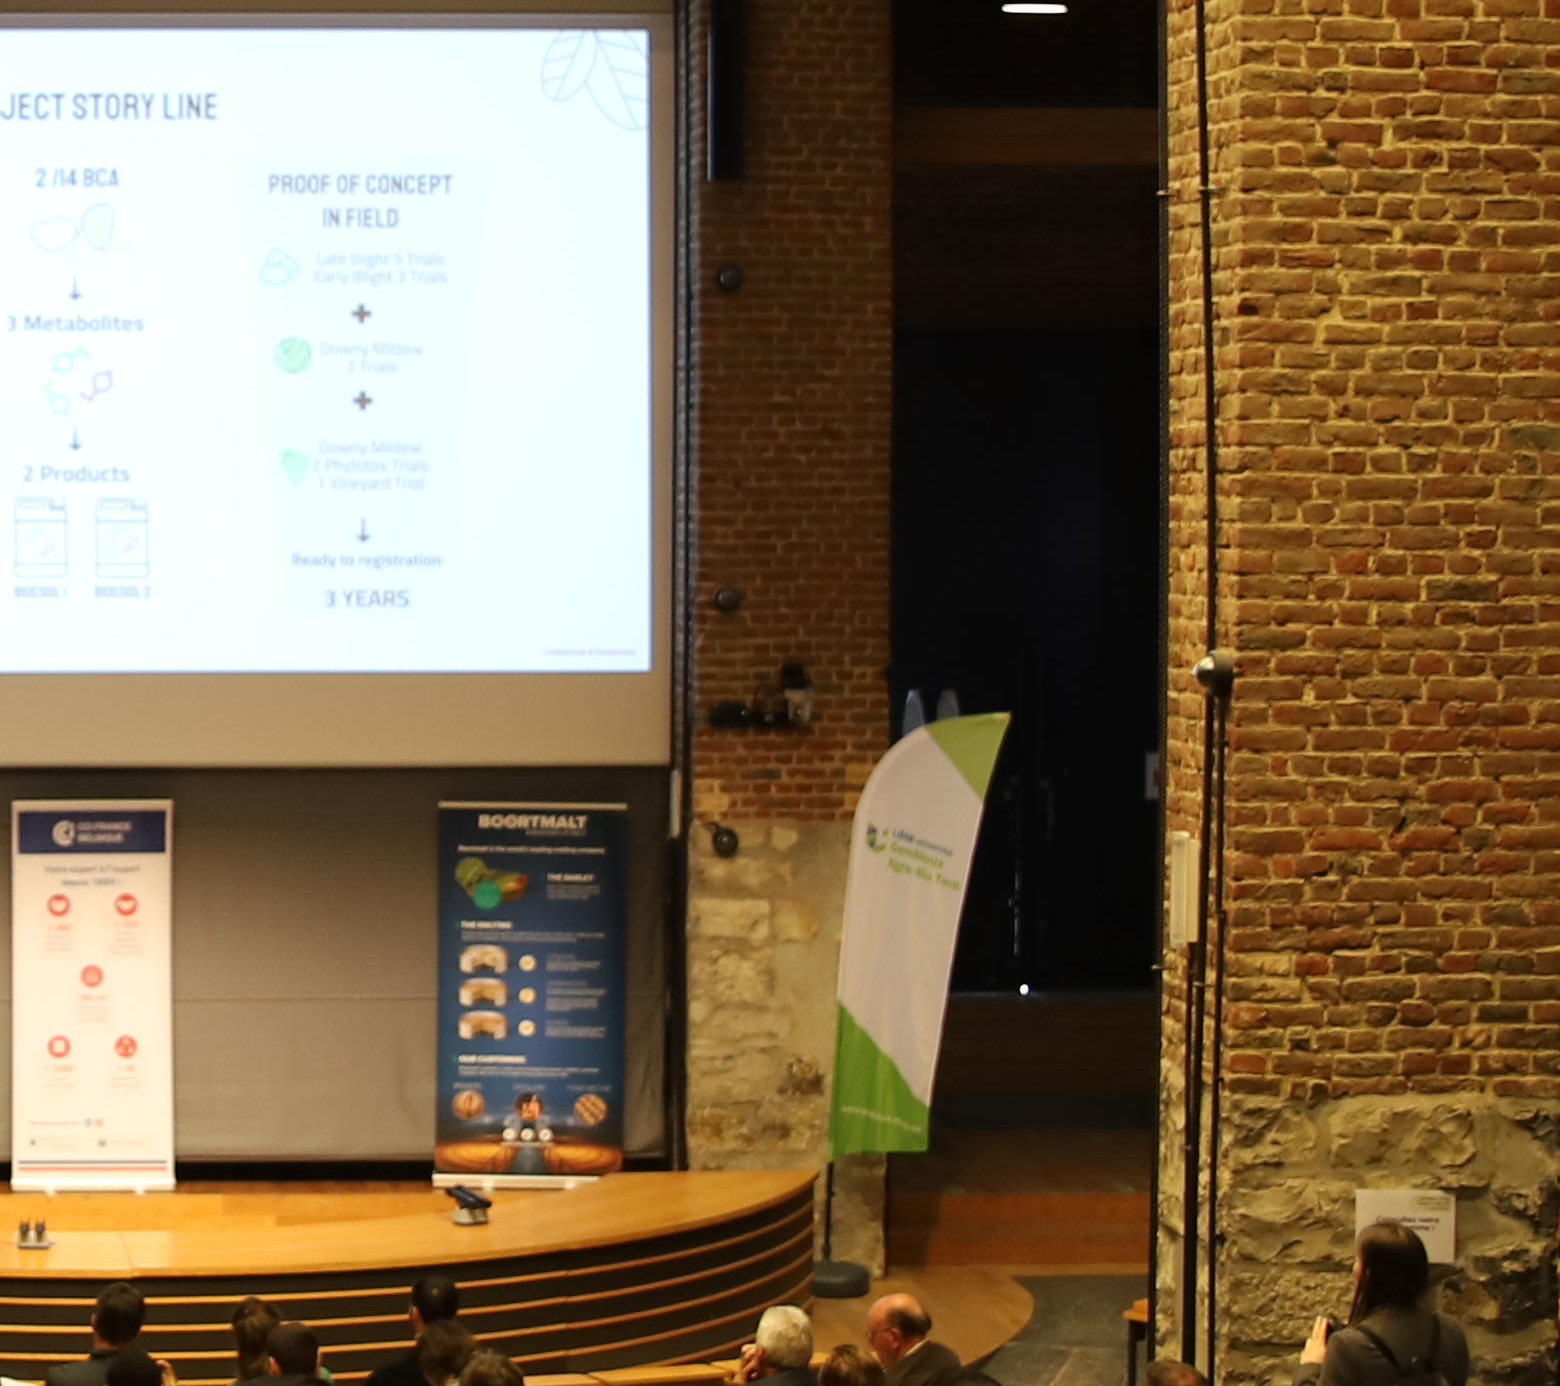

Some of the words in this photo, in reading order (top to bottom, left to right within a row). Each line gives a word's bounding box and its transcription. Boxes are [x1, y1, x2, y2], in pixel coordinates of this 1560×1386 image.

[71, 92, 155, 120] STORY
[163, 92, 218, 120] LINE
[35, 168, 47, 188] 2
[83, 168, 120, 188] BCA
[268, 174, 331, 195] PROOF
[336, 174, 360, 195] OF
[365, 174, 453, 195] CONCEPT
[322, 207, 340, 228] IN
[345, 207, 399, 228] FIELD
[316, 252, 347, 266] Late
[350, 252, 389, 269] blight
[406, 252, 444, 266] Trials
[313, 270, 348, 286] Early
[352, 270, 392, 286] Blight
[398, 270, 406, 284] 3
[410, 270, 448, 284] Trials
[6, 314, 17, 332] 3
[23, 314, 144, 332] Metabolites
[320, 342, 367, 359] Downy
[372, 342, 423, 356] Mildew
[347, 360, 355, 374] 2
[359, 360, 397, 374] Trials
[318, 440, 367, 457] Downy
[371, 440, 422, 454] Mildew
[22, 465, 33, 483] 2
[40, 464, 131, 483] Products
[312, 459, 320, 473] 2
[324, 459, 387, 476] Phytotox
[391, 459, 429, 473] Trials
[329, 477, 390, 493] Vineyard
[394, 477, 424, 490] Trial
[291, 554, 336, 569] Ready
[340, 554, 354, 566] to
[358, 554, 443, 570] registration
[324, 589, 336, 607] 3
[342, 589, 411, 607] YEARS
[478, 814, 587, 829] BOORTMALT
[890, 842, 944, 868] Gembloux
[936, 873, 960, 891] Tech
